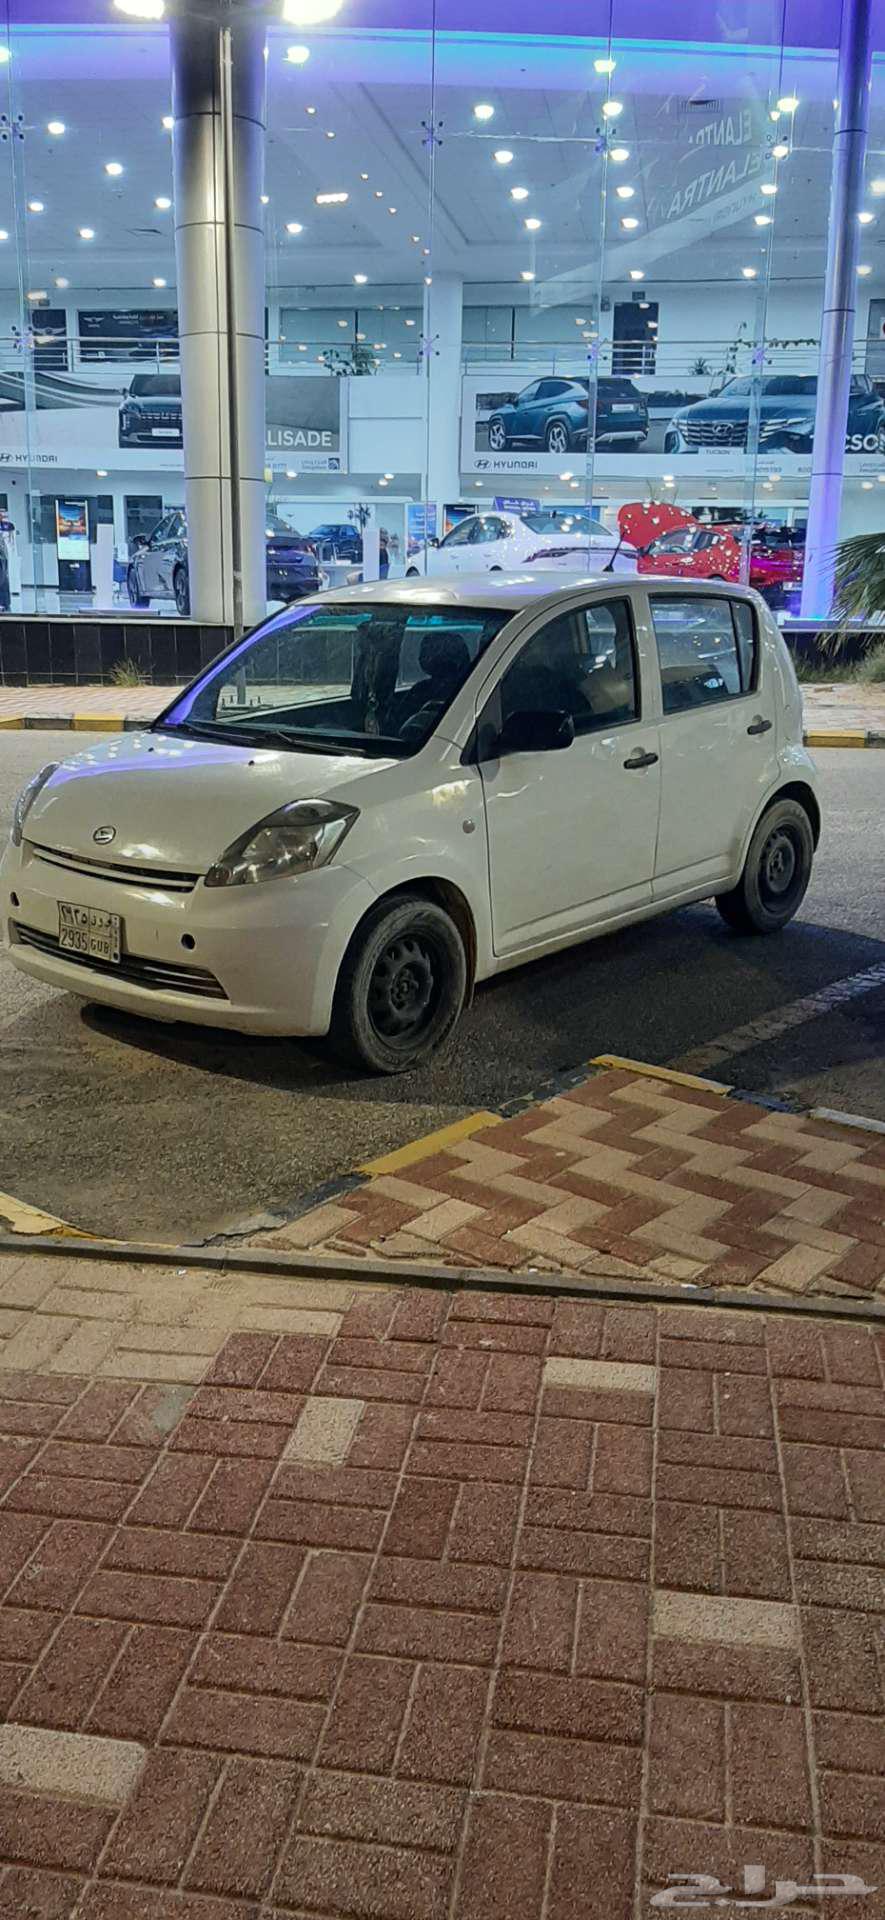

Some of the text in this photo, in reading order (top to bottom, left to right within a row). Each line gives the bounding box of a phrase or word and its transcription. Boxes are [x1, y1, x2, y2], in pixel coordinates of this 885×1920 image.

[264, 430, 332, 447] LISADE
[493, 460, 538, 469] HYUNDAI
[61, 928, 88, 951] 2935
[90, 938, 109, 954] GUB
